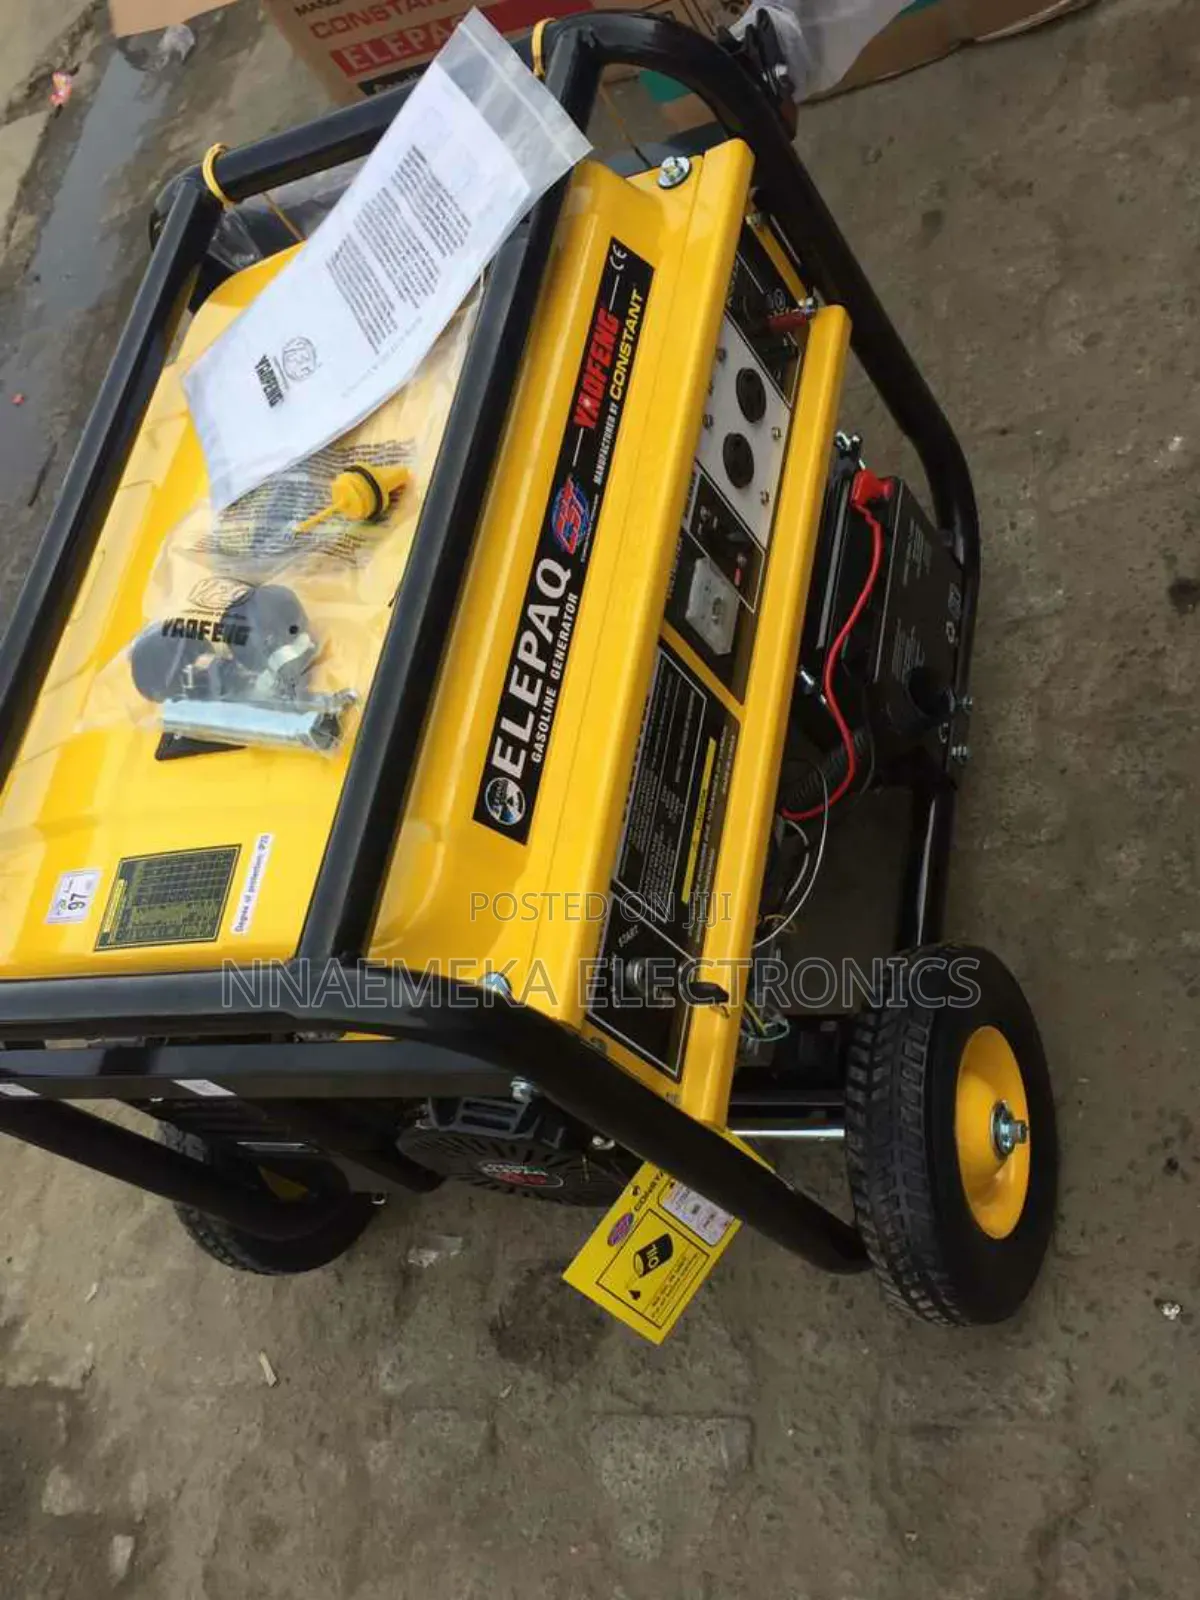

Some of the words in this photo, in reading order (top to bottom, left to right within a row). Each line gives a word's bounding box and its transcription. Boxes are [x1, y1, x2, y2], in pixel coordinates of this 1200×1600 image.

[341, 16, 461, 70] ELEPA
[573, 307, 621, 430] YAOFENG
[592, 418, 614, 486] MANUFACTURED
[609, 288, 644, 401] CONSTANT
[161, 616, 250, 647] YAOFENG
[492, 557, 573, 780] ELEPAQ
[531, 685, 558, 764] GASOLINE
[550, 592, 579, 680] GENERATOR
[67, 892, 89, 912] 97
[646, 1244, 660, 1269] OIL
